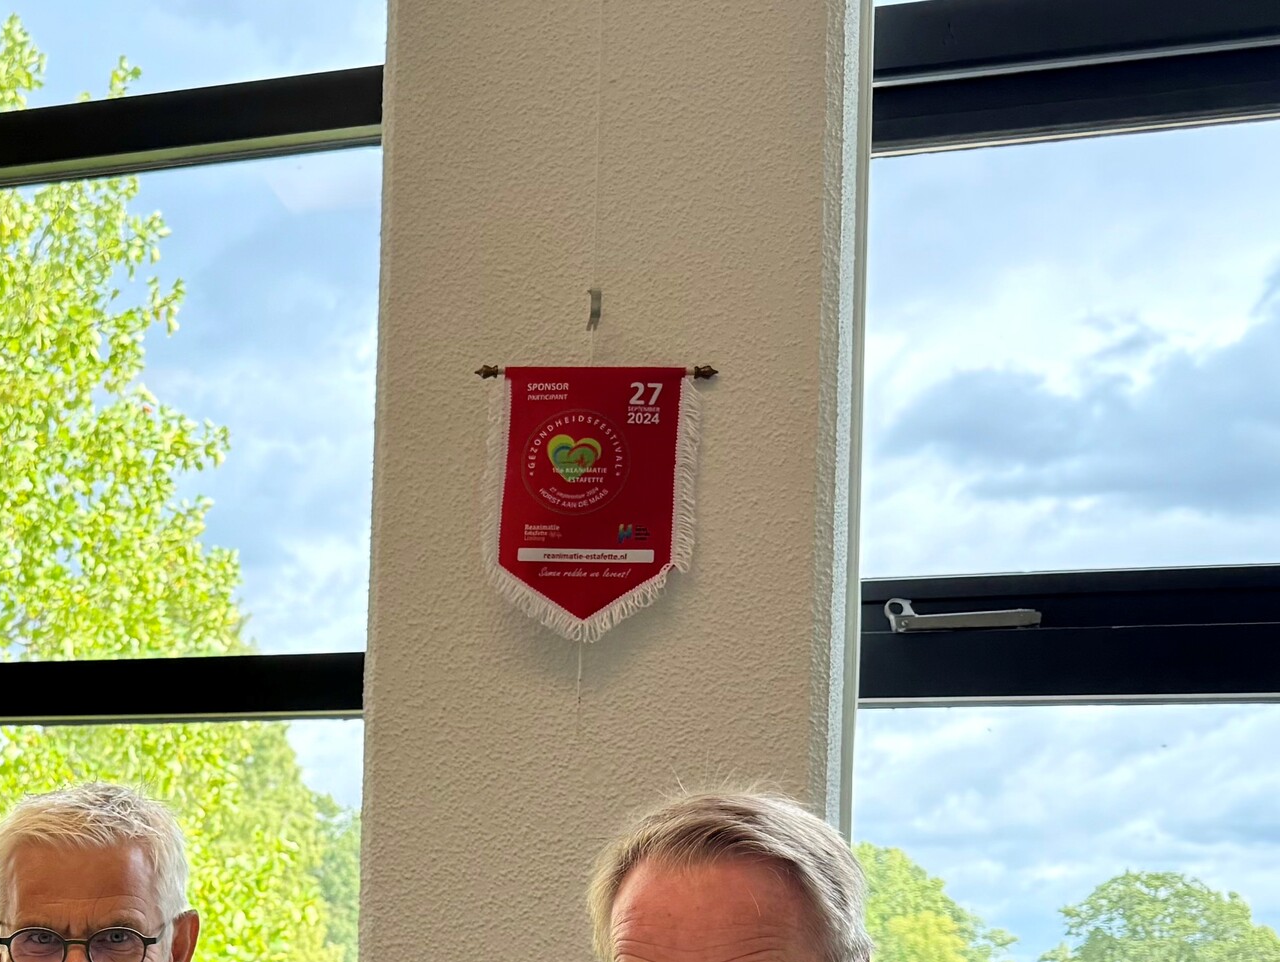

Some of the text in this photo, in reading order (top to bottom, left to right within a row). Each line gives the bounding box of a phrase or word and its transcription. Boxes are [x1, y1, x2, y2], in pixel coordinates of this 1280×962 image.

[527, 382, 569, 392] SPONSOR
[527, 393, 568, 401] PARTICIPANT
[628, 382, 664, 406] 27
[627, 412, 660, 424] 2024
[527, 415, 623, 469] GEZONDHEIDSFESTIVAL
[539, 488, 561, 505] HORST
[543, 552, 628, 561] reanimatie-estafette.nl
